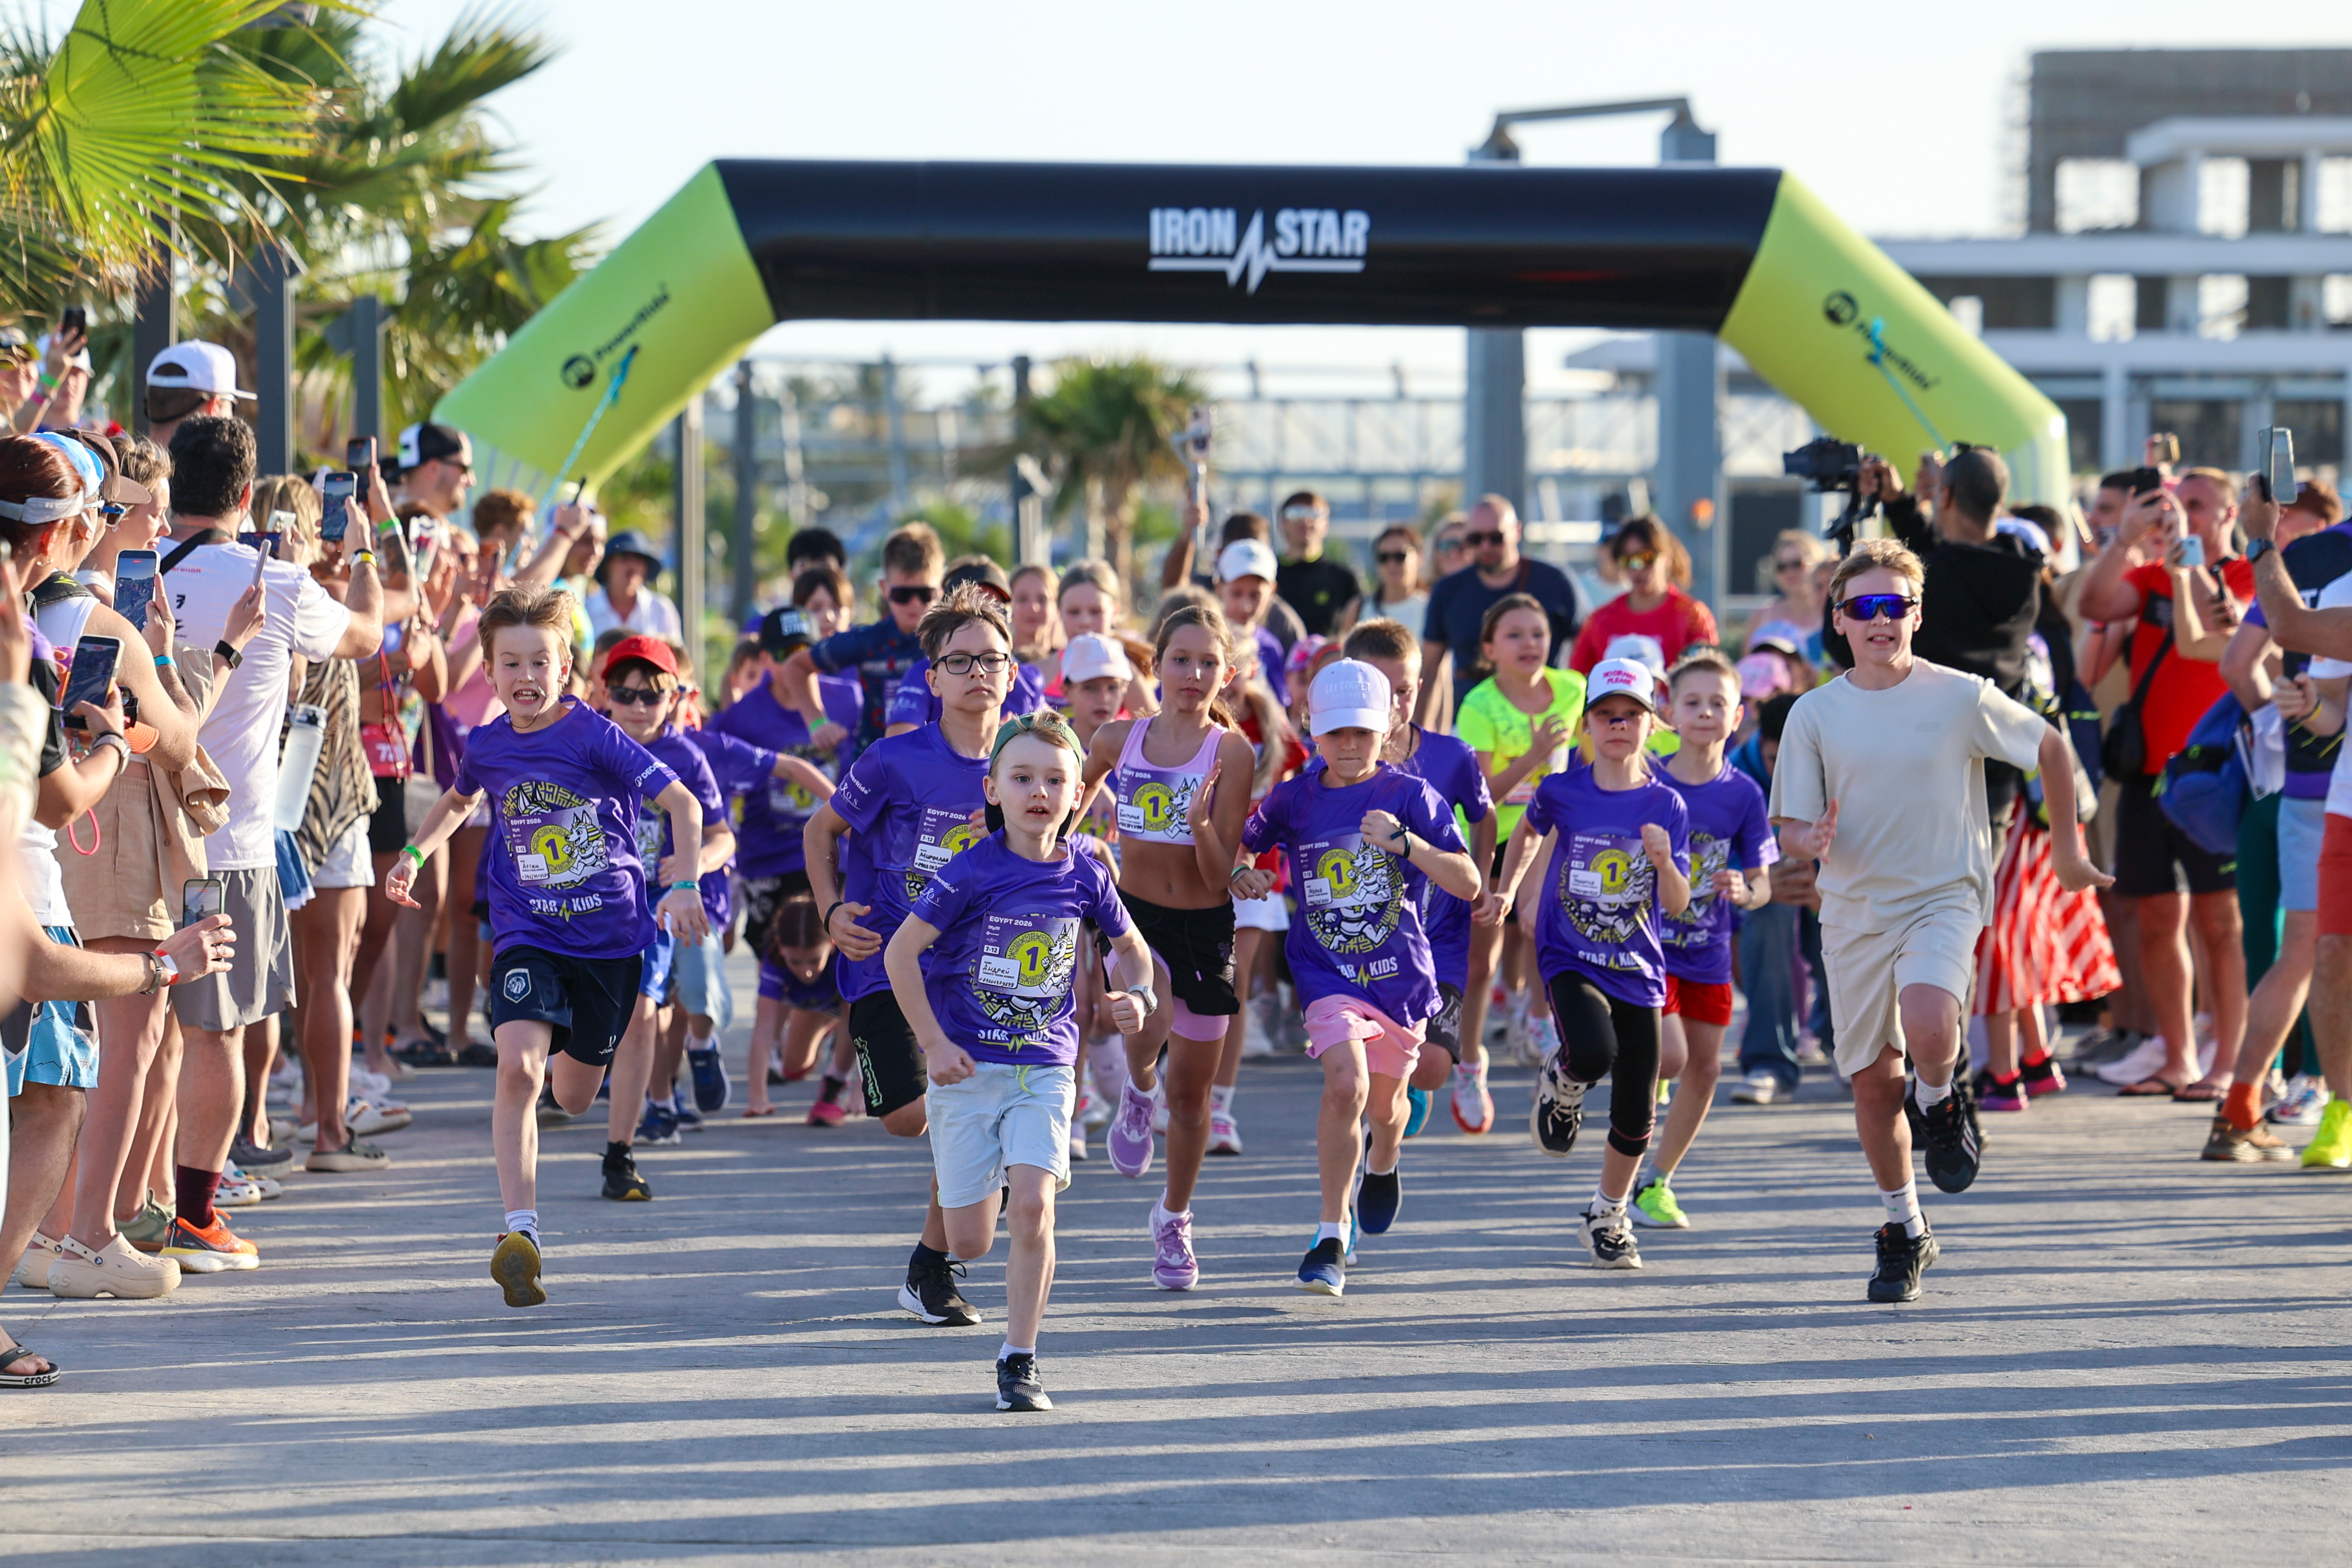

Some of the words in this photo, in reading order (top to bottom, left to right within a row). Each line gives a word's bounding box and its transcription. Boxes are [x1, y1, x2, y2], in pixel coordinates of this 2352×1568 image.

[1149, 207, 1237, 255] IRON
[1274, 208, 1371, 256] STAR
[1326, 684, 1339, 693] LEE
[1607, 678, 1633, 686] PLEASE
[927, 809, 949, 817] EGYPT
[1148, 796, 1160, 817] 1
[545, 838, 560, 860] 1
[1330, 862, 1343, 884] 1
[1607, 862, 1618, 882] 1
[529, 899, 558, 912] STAR
[571, 893, 602, 912] KIDS
[989, 916, 1013, 925] EGYPT
[1026, 947, 1039, 971] 1
[1369, 956, 1398, 976] KIDS
[983, 964, 1010, 974] Андрей
[24, 1375, 51, 1384] crocs
